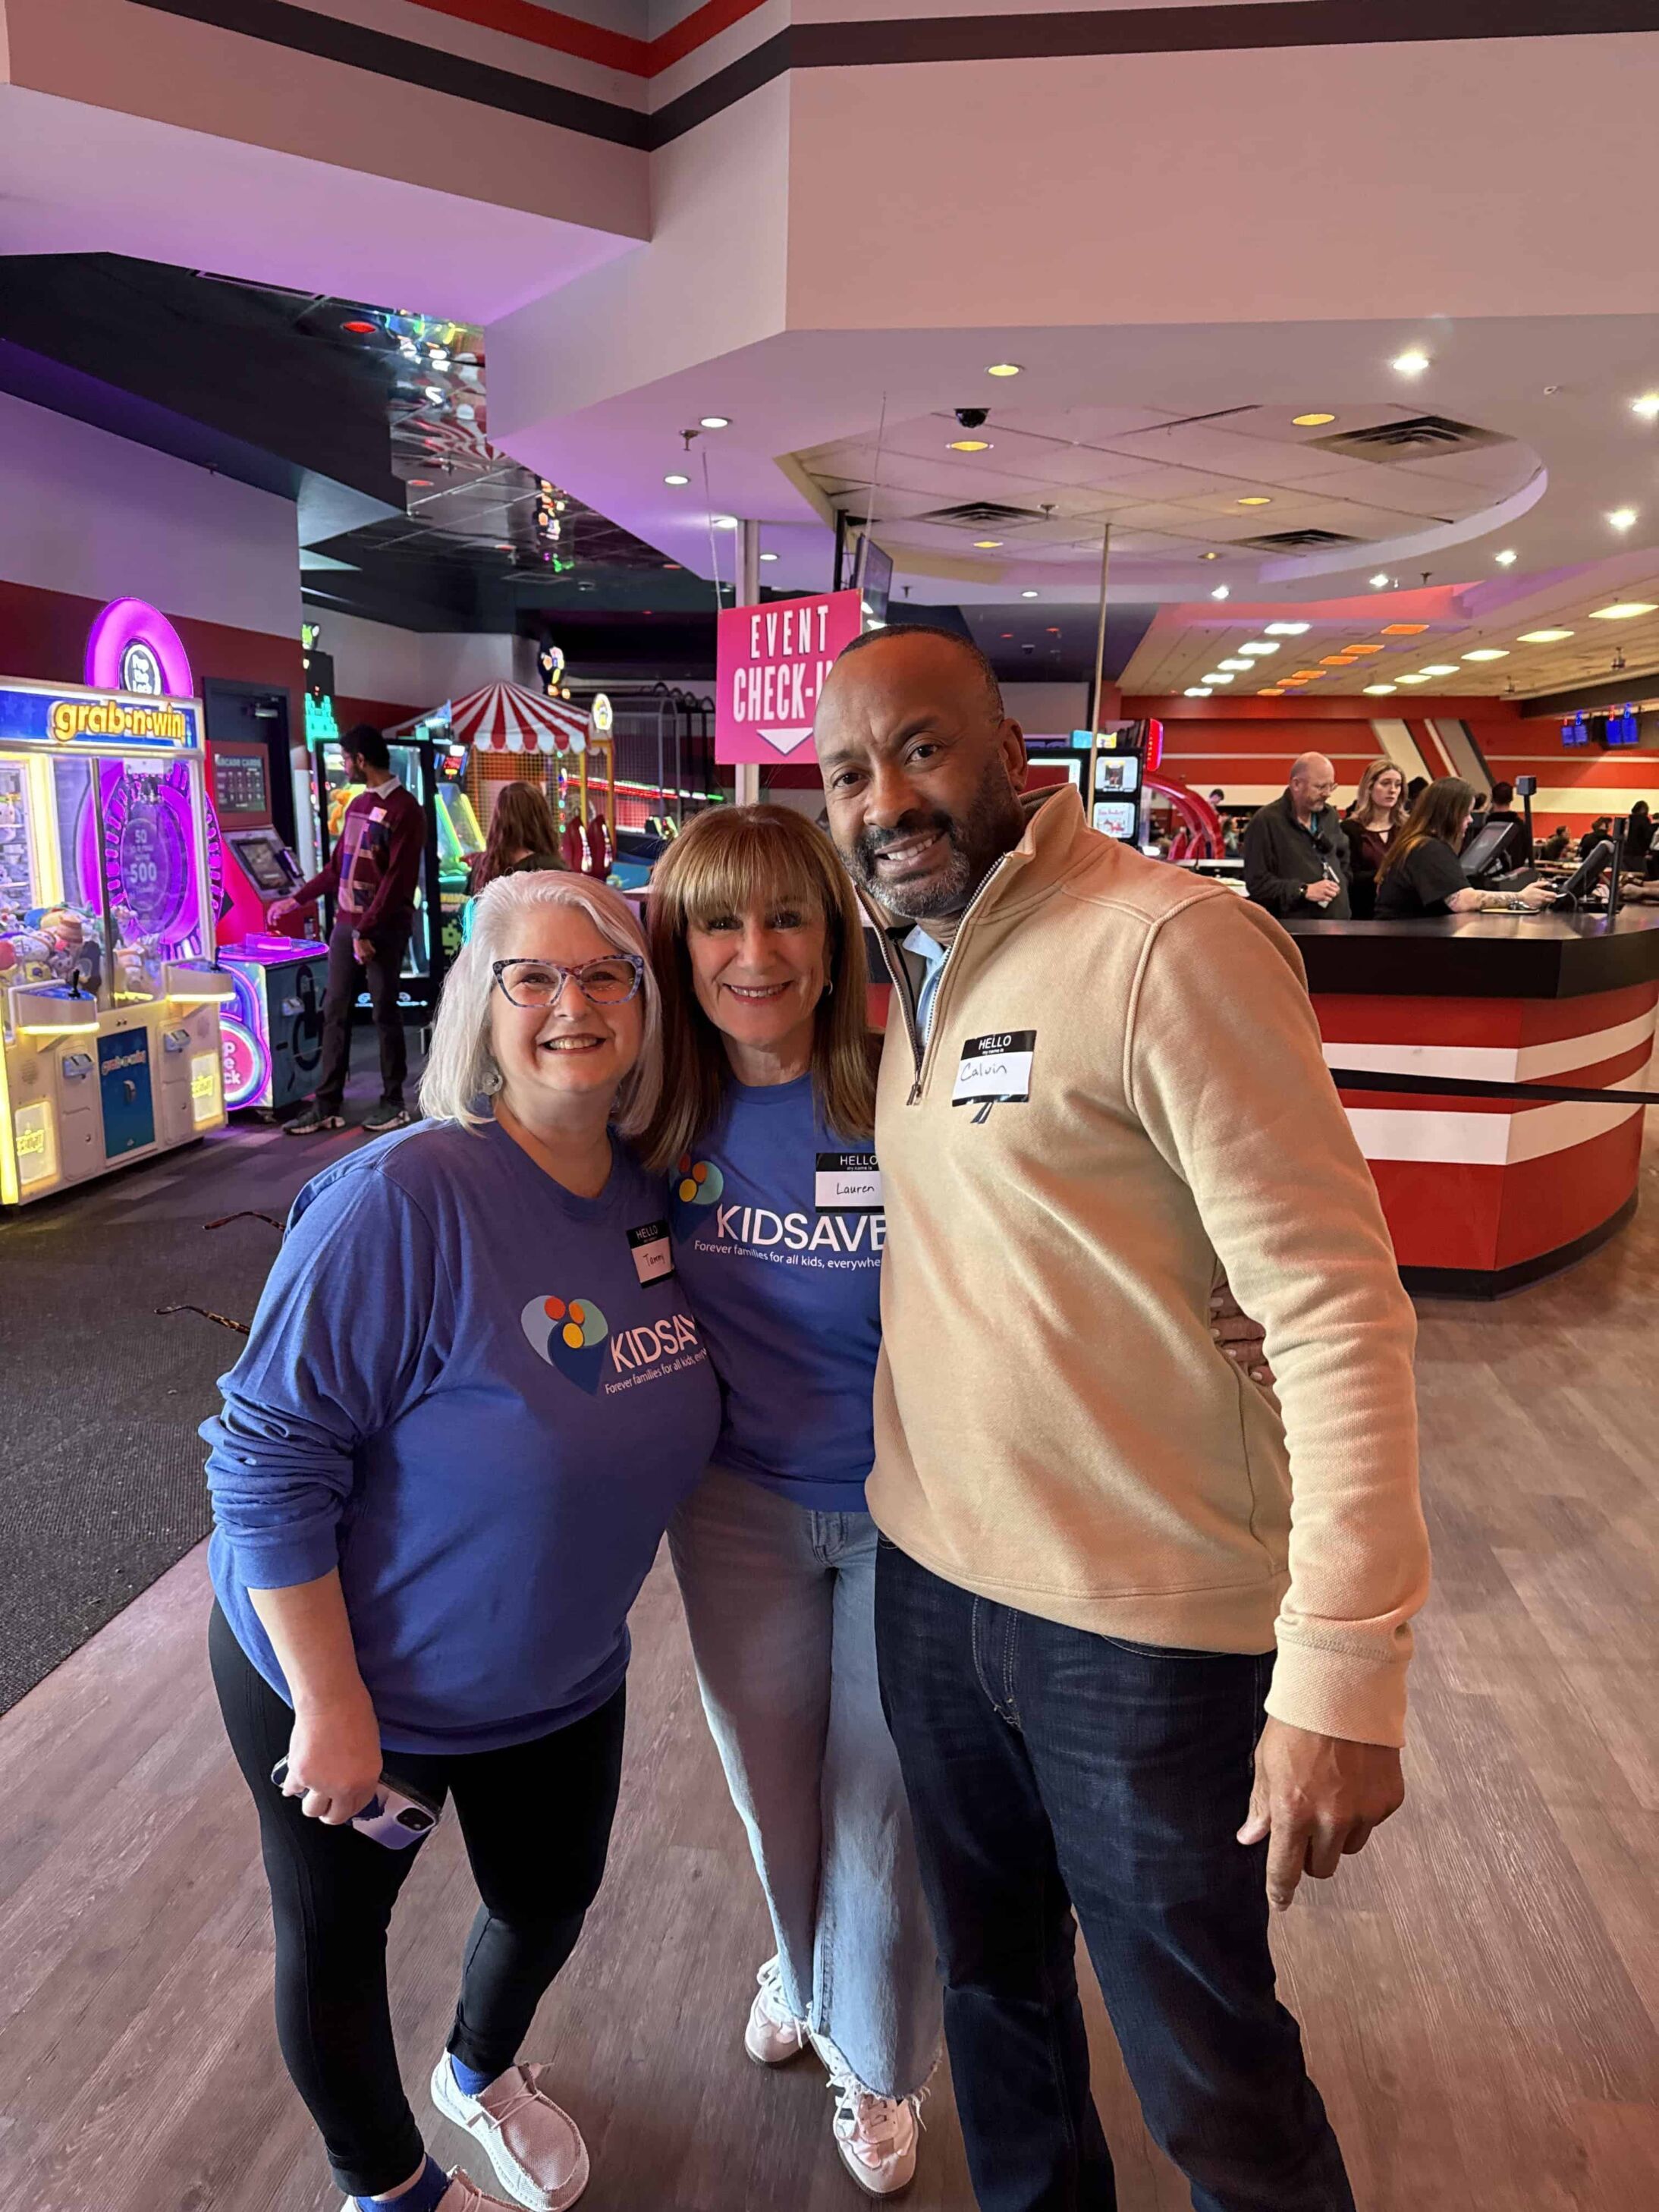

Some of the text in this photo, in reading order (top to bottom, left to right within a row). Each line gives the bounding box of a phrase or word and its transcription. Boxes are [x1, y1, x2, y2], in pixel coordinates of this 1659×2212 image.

[750, 605, 828, 660] EVENT
[130, 862, 157, 883] 500
[979, 1035, 1012, 1051] HELLO
[960, 1062, 1007, 1082] Calvin
[840, 1155, 878, 1166] HELLO
[836, 1182, 875, 1195] Lauren
[635, 1224, 658, 1240] HELLO
[717, 1203, 886, 1252] KIDSAVE
[694, 1240, 881, 1271] Forever families for all kids, everywhe
[605, 1378, 633, 1395] Forever
[632, 1368, 662, 1386] families
[661, 1363, 673, 1375] for
[673, 1359, 682, 1371] all
